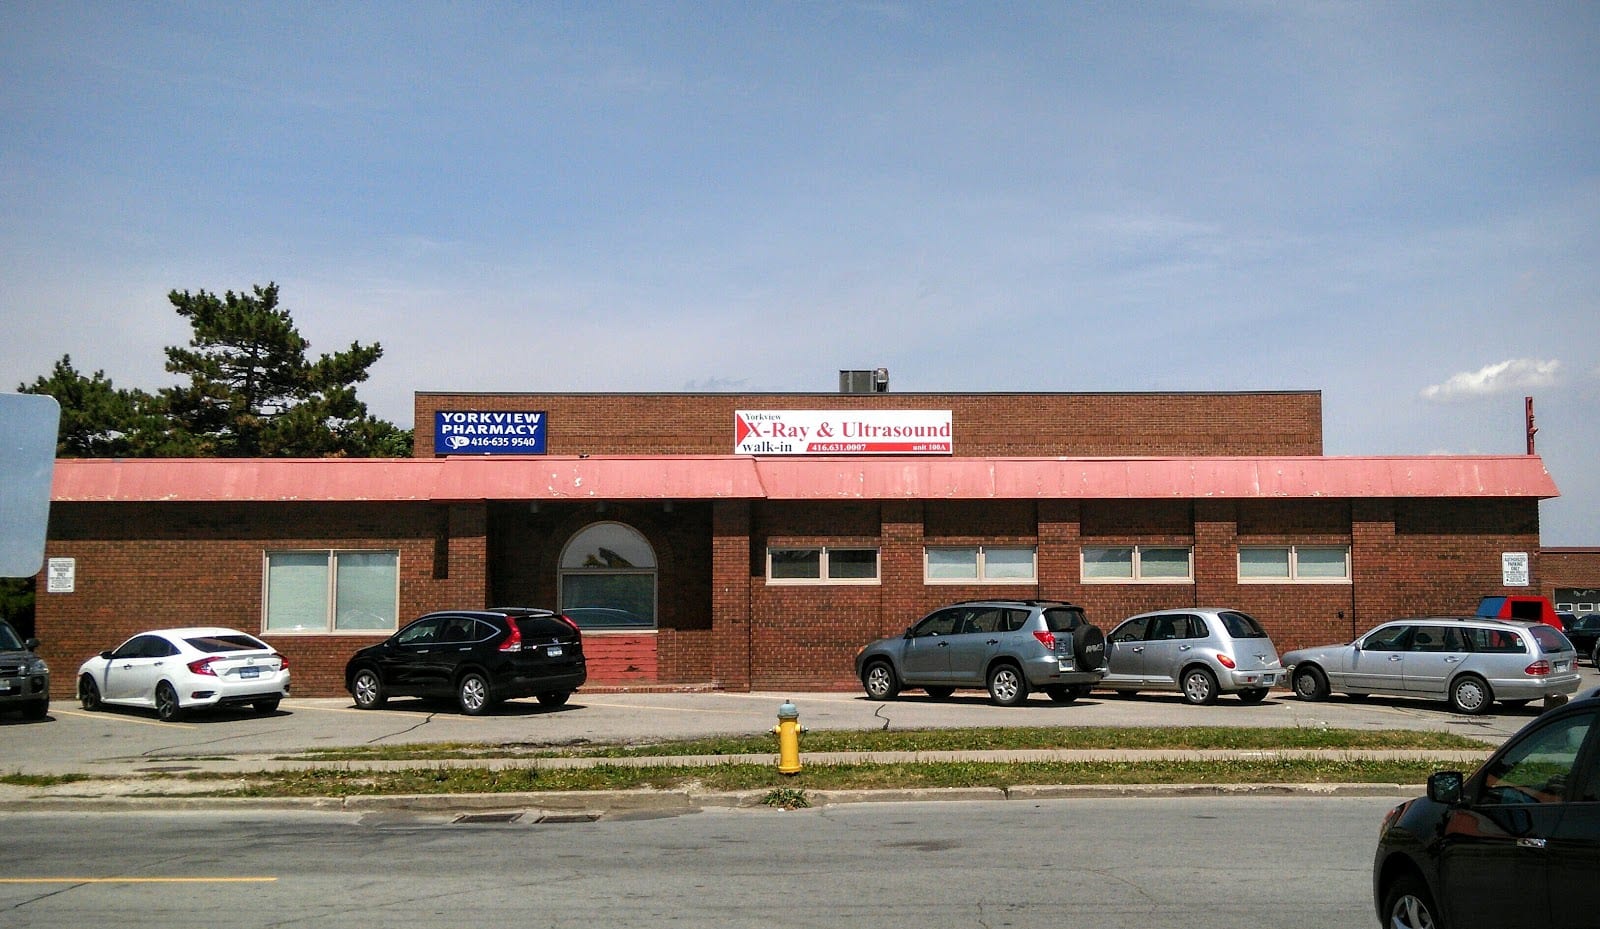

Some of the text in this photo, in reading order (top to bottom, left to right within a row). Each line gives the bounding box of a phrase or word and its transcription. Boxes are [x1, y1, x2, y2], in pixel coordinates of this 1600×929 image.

[441, 413, 541, 423] YORKVIEW
[745, 413, 781, 421] Yorkview
[441, 424, 538, 434] PHARMACY
[747, 421, 951, 442] X-Ray & Ultrasound
[471, 437, 509, 446] 416-635
[511, 437, 535, 446] 9540
[743, 441, 792, 452] walk-in
[812, 443, 867, 451] 416.631.0007
